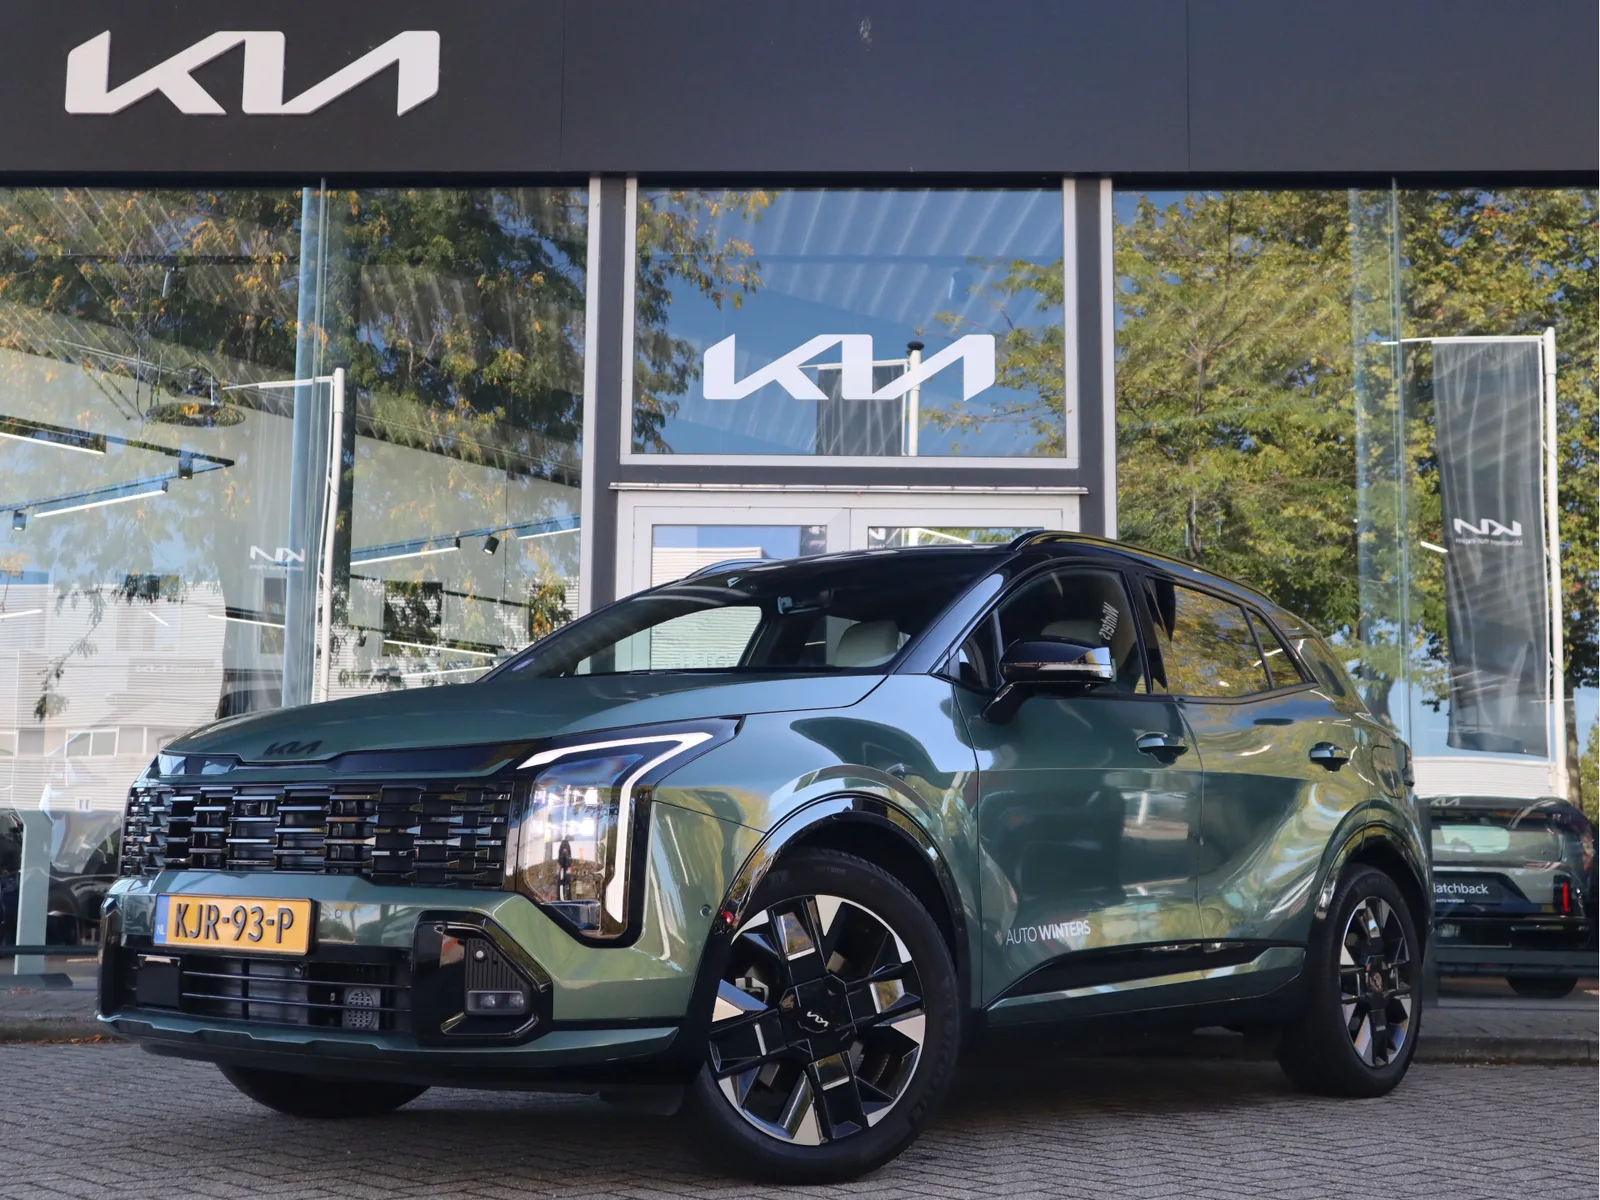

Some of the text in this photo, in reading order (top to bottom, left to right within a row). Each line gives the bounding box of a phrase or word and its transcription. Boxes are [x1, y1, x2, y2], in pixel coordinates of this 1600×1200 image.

[65, 30, 440, 117] KIA
[703, 333, 996, 401] KIA
[263, 740, 323, 756] KIA
[156, 924, 166, 935] NL
[174, 903, 294, 944] KJR-93-P
[1005, 920, 1091, 946] AUTO WINTERS
